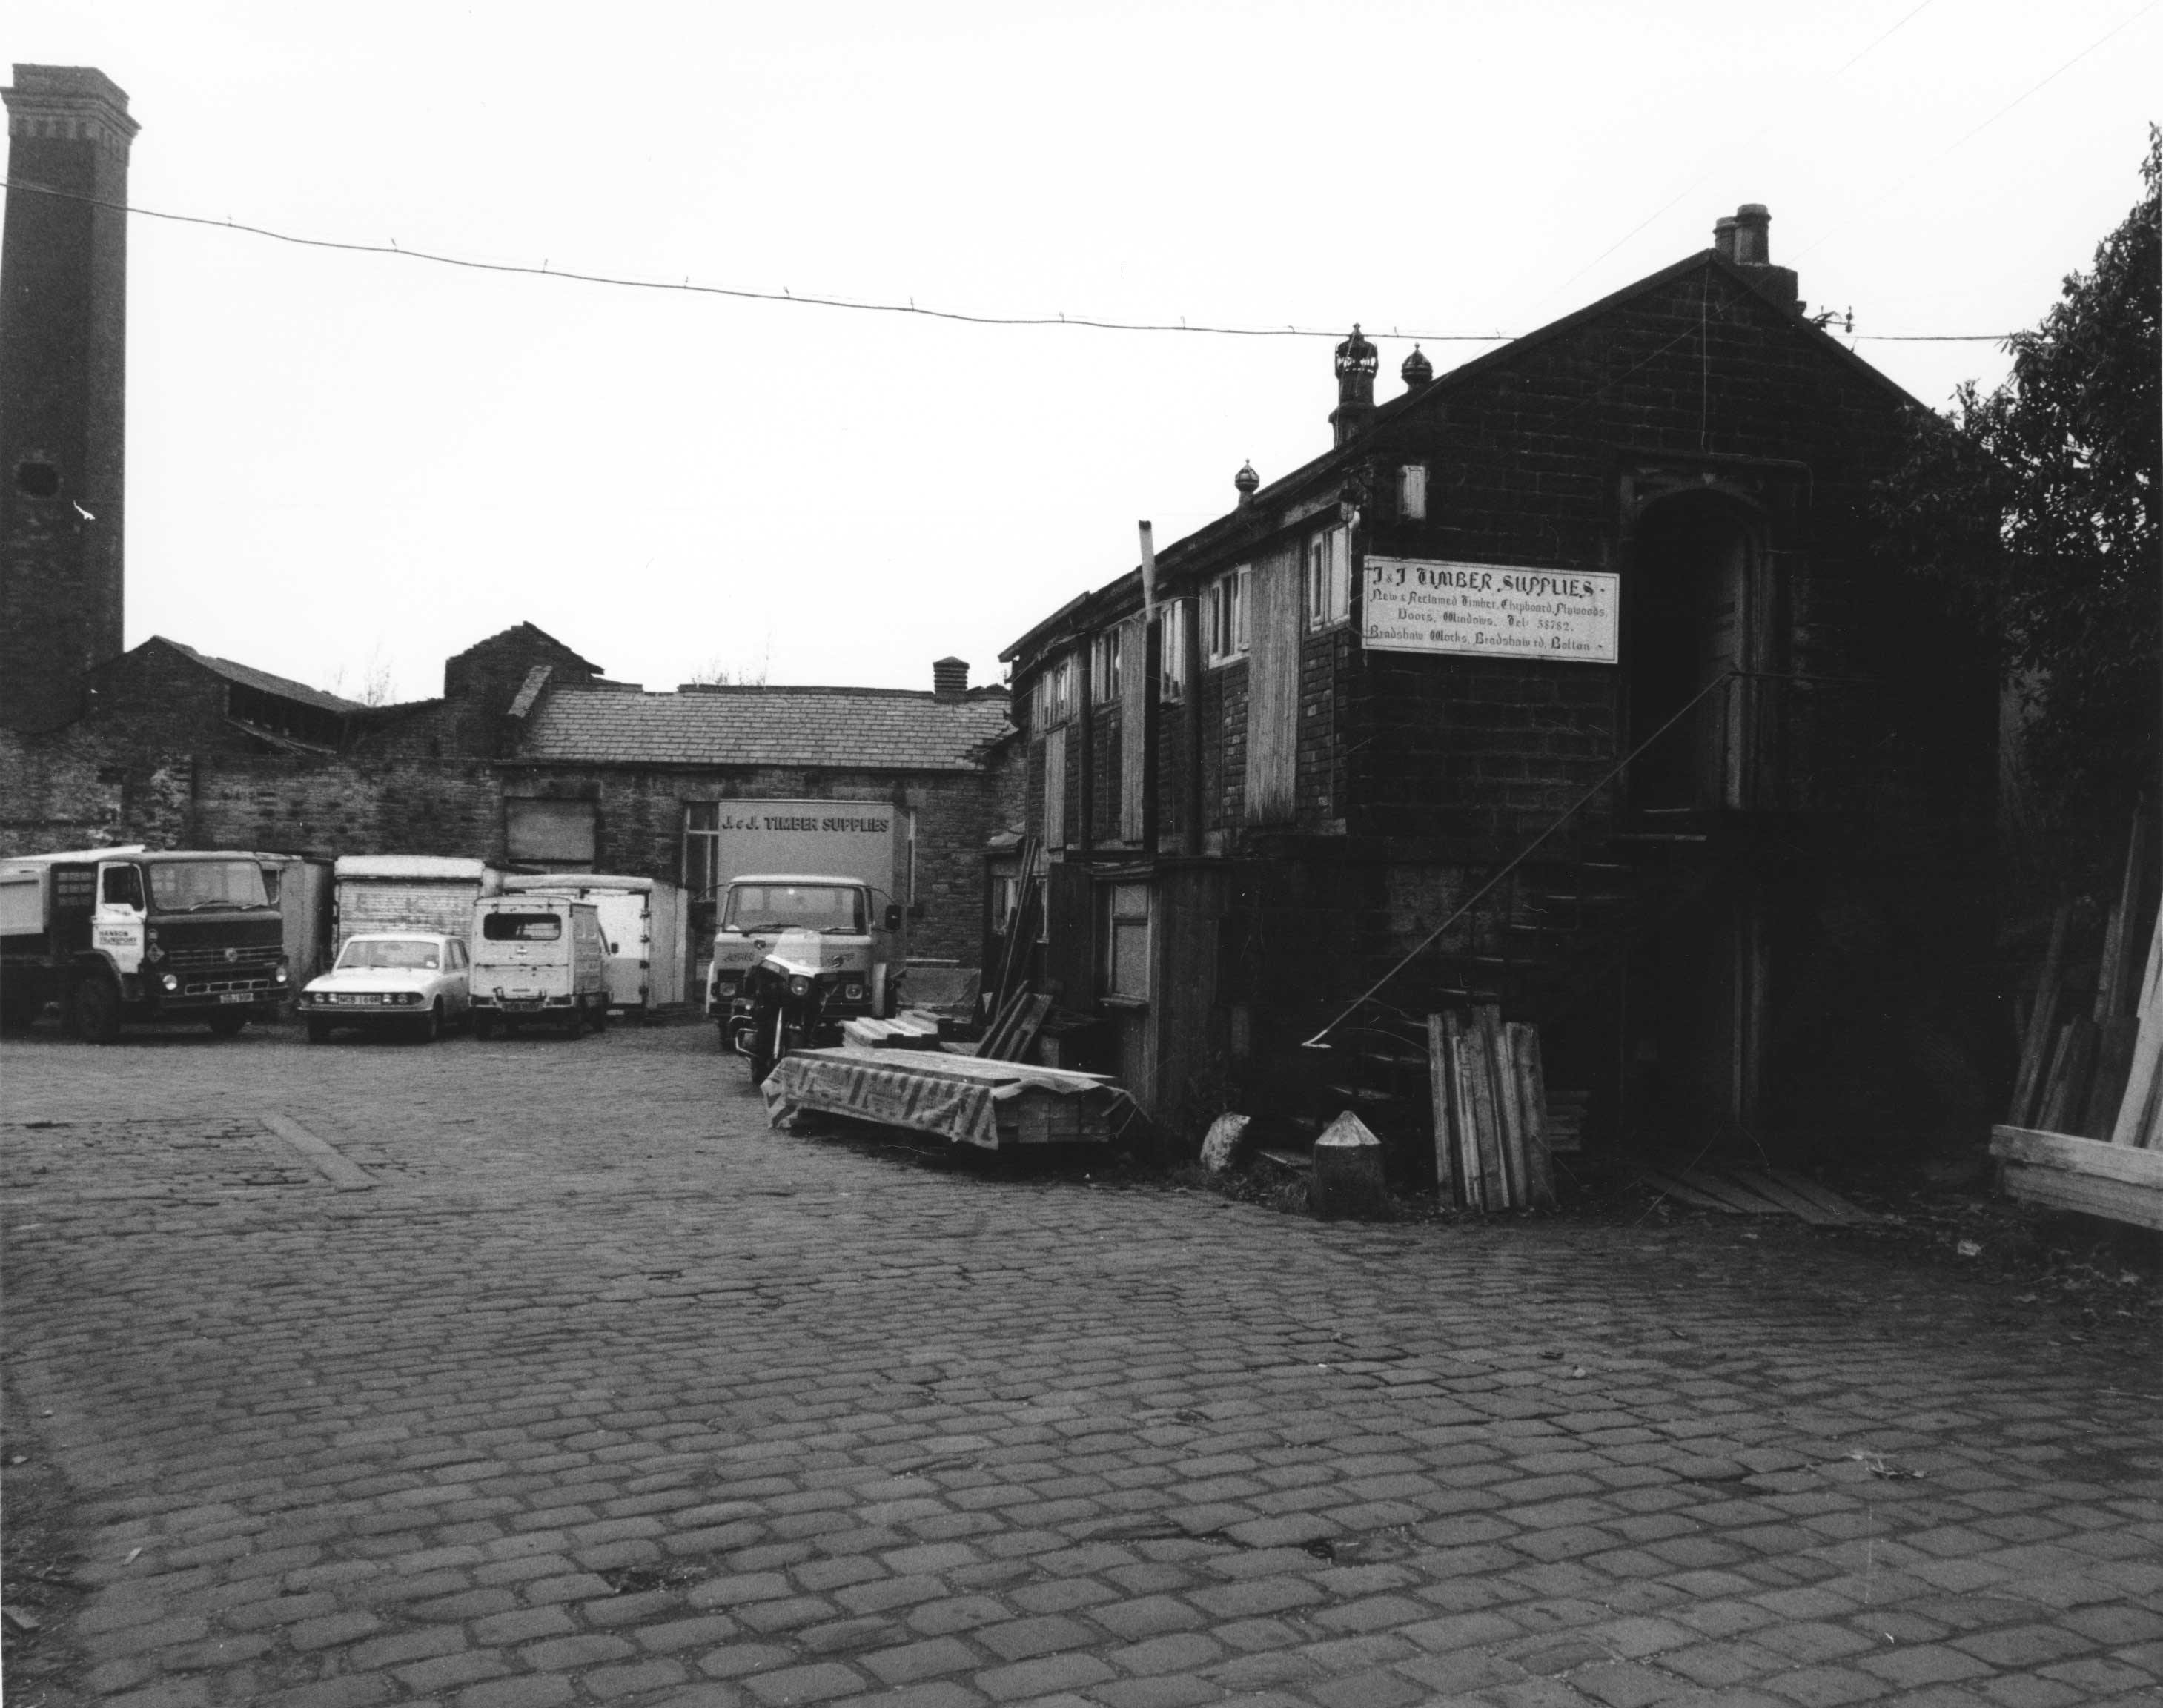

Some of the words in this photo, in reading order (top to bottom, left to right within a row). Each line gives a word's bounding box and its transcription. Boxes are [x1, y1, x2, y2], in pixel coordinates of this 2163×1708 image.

[1386, 573, 1394, 583] &
[1417, 567, 1493, 592] TIMBER
[1497, 575, 1594, 598] SUPPLIES
[1369, 588, 1397, 602] New
[1369, 624, 1423, 640] Bradshaw
[1475, 632, 1531, 647] Bradshaw
[1551, 636, 1591, 652] Bolton
[763, 817, 818, 831] TIMBER
[822, 818, 890, 833] SUPPLIES
